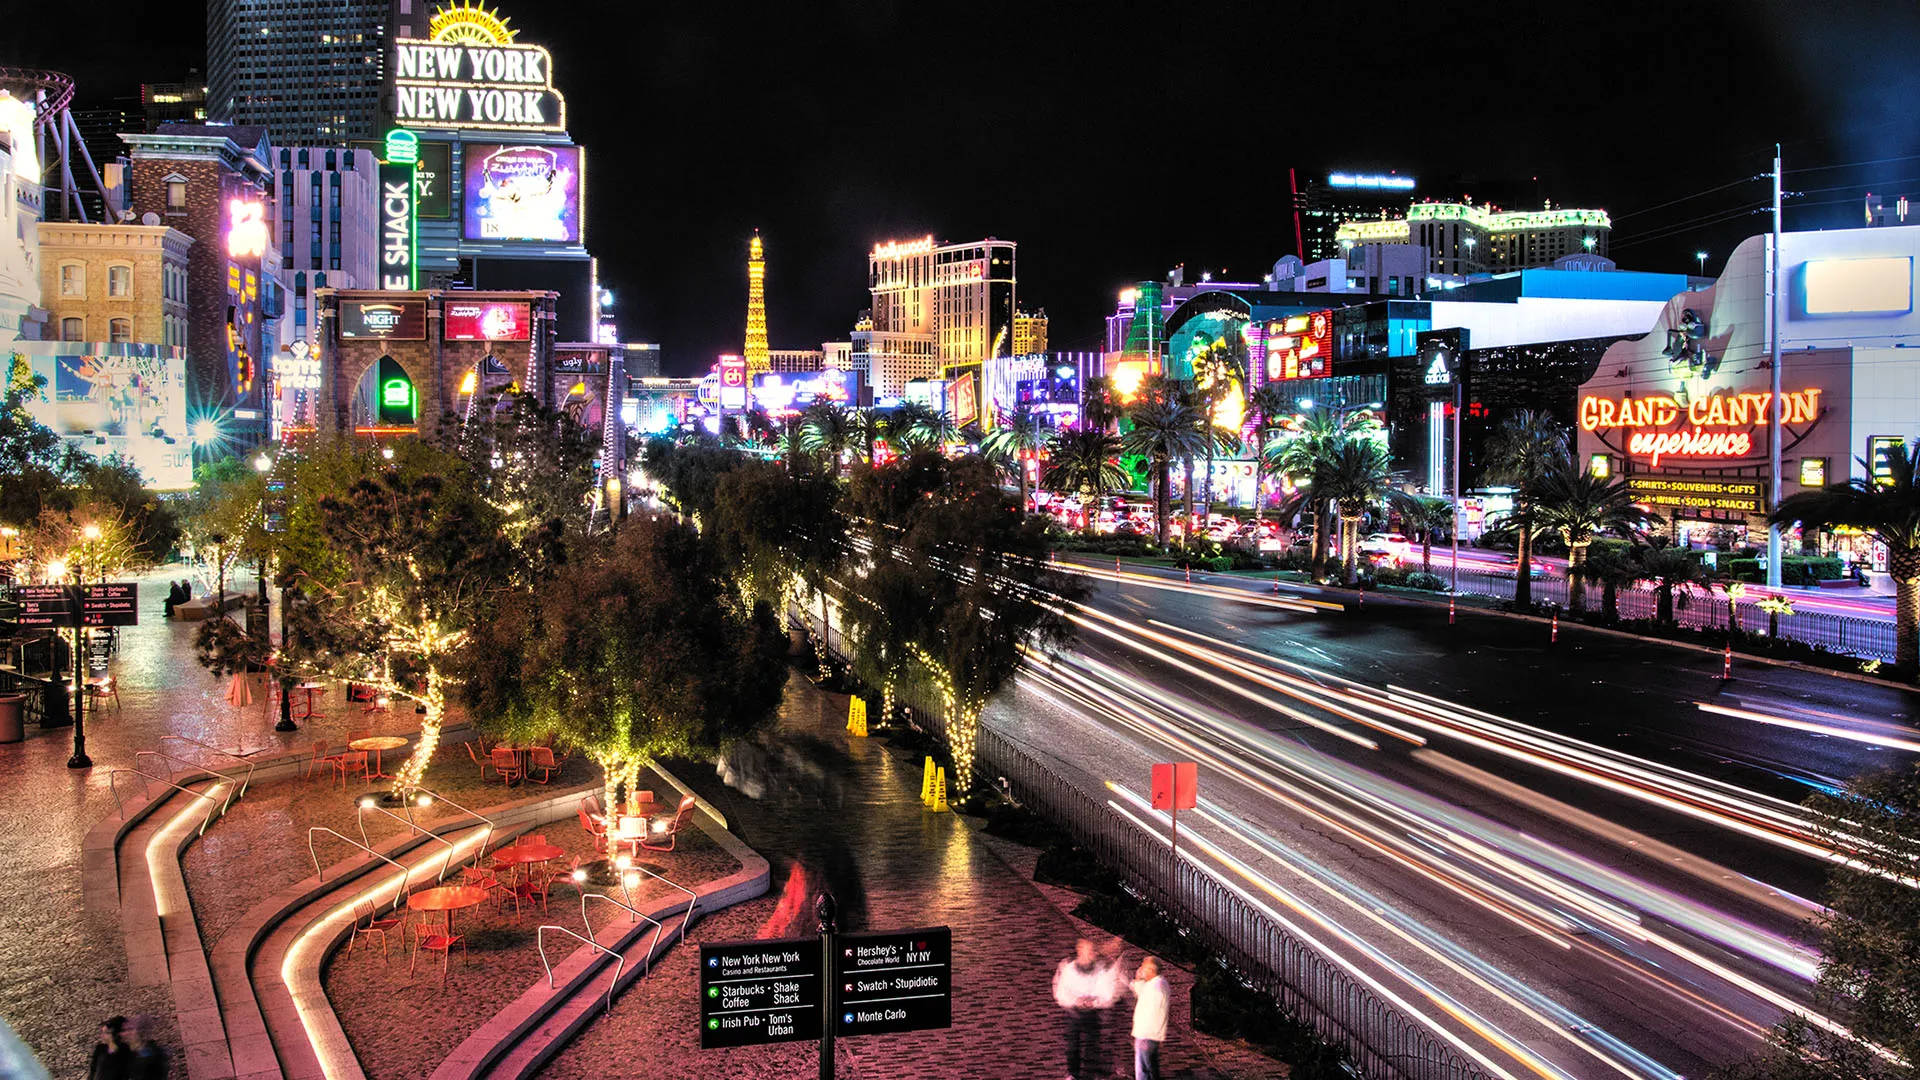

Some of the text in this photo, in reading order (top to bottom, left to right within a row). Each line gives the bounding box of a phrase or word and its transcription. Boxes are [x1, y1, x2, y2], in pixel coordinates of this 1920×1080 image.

[396, 45, 545, 82] NEW YORK
[396, 87, 545, 122] NEW YORK
[385, 182, 409, 266] SHACK
[363, 314, 401, 325] NIGHT
[562, 357, 583, 367] ugly
[1581, 395, 1678, 431] GRAND
[1630, 427, 1750, 466] experience
[1671, 481, 1723, 493] SOUVENIRS
[1728, 484, 1756, 494] GIFTS
[1656, 496, 1681, 505] WINE
[1685, 497, 1711, 507] SODA
[1716, 499, 1756, 510] SNACKS
[857, 945, 897, 957] Hershey's
[857, 951, 931, 966] Chocolate World NY NY
[722, 952, 800, 967] New York New York
[722, 968, 741, 976] Casino
[754, 965, 787, 974] Restaurants
[722, 982, 799, 997] Starbucks Shake
[857, 976, 938, 992] Swatch Stupidiotic
[722, 993, 800, 1009] Coffee Shack
[722, 1014, 792, 1029] Irish Pub Tom's
[857, 1009, 906, 1023] Monte Carlo
[768, 1025, 793, 1036] Urban
